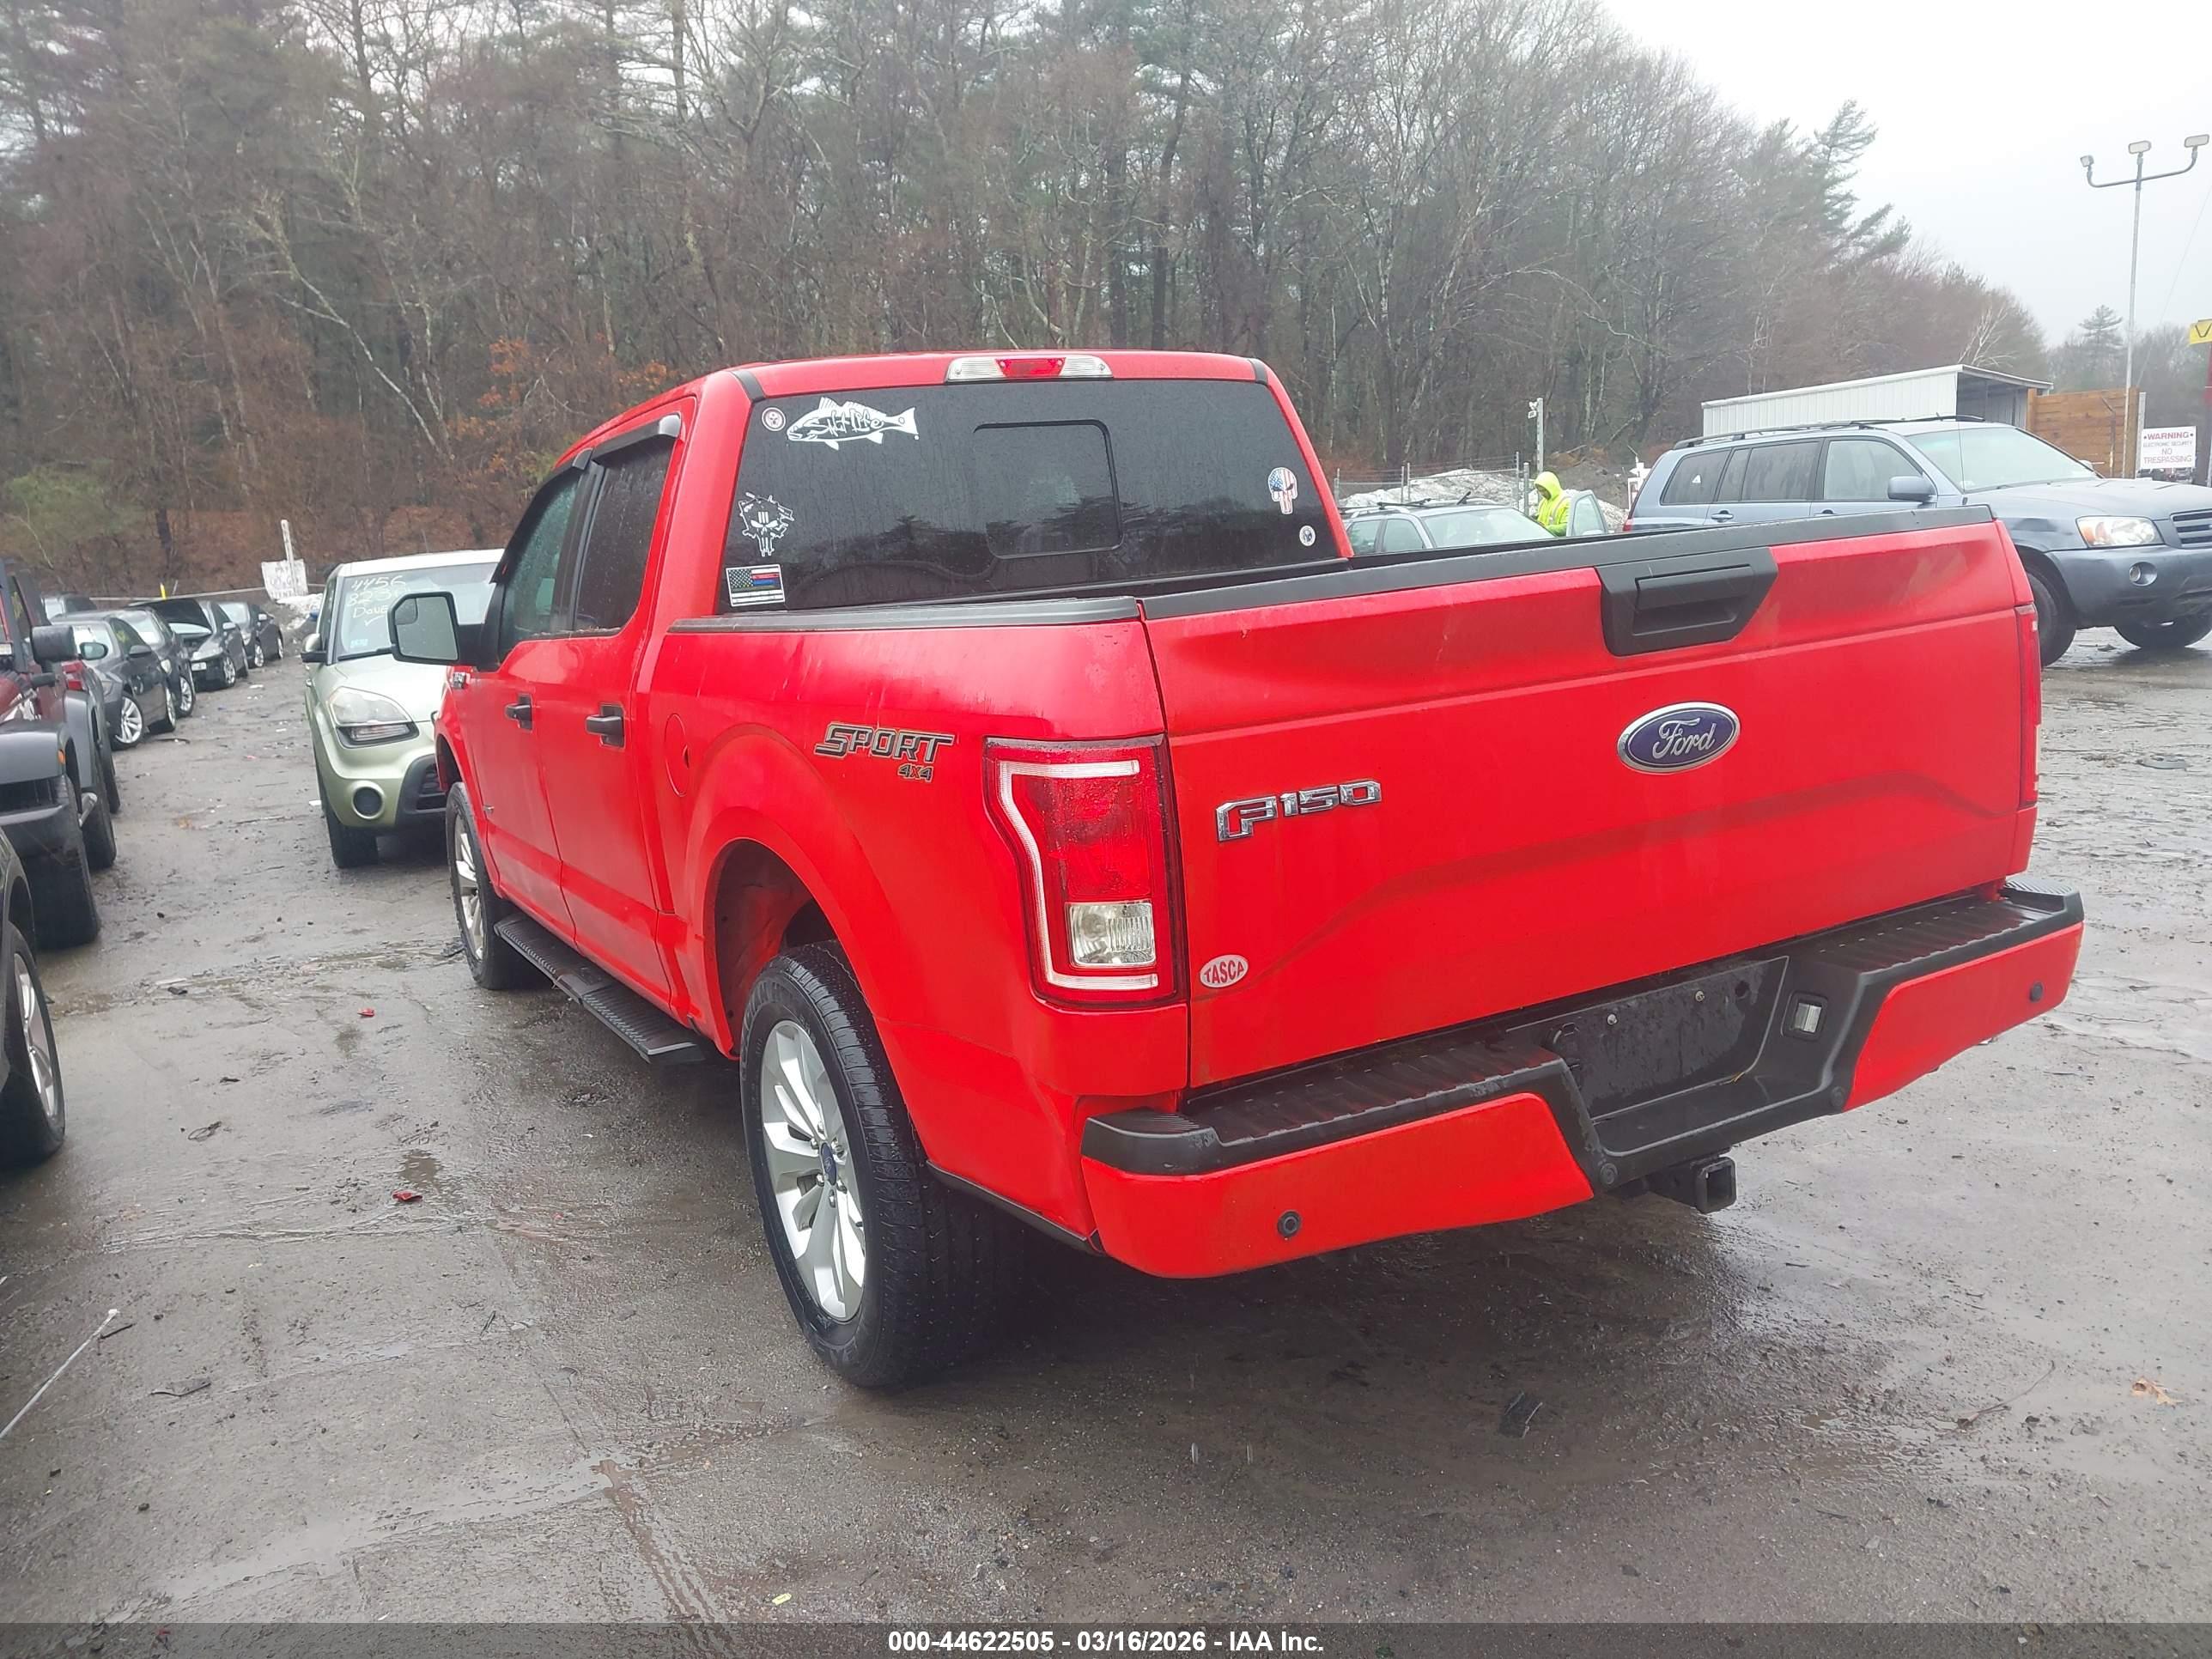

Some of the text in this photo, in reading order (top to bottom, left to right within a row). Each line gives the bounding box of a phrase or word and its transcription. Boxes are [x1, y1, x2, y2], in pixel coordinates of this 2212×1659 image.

[2147, 431, 2190, 441] WARNING
[2143, 454, 2192, 465] TRESPASSING
[814, 721, 955, 763] SPORT
[1652, 718, 1717, 759] Ford
[1204, 960, 1244, 984] TASCA
